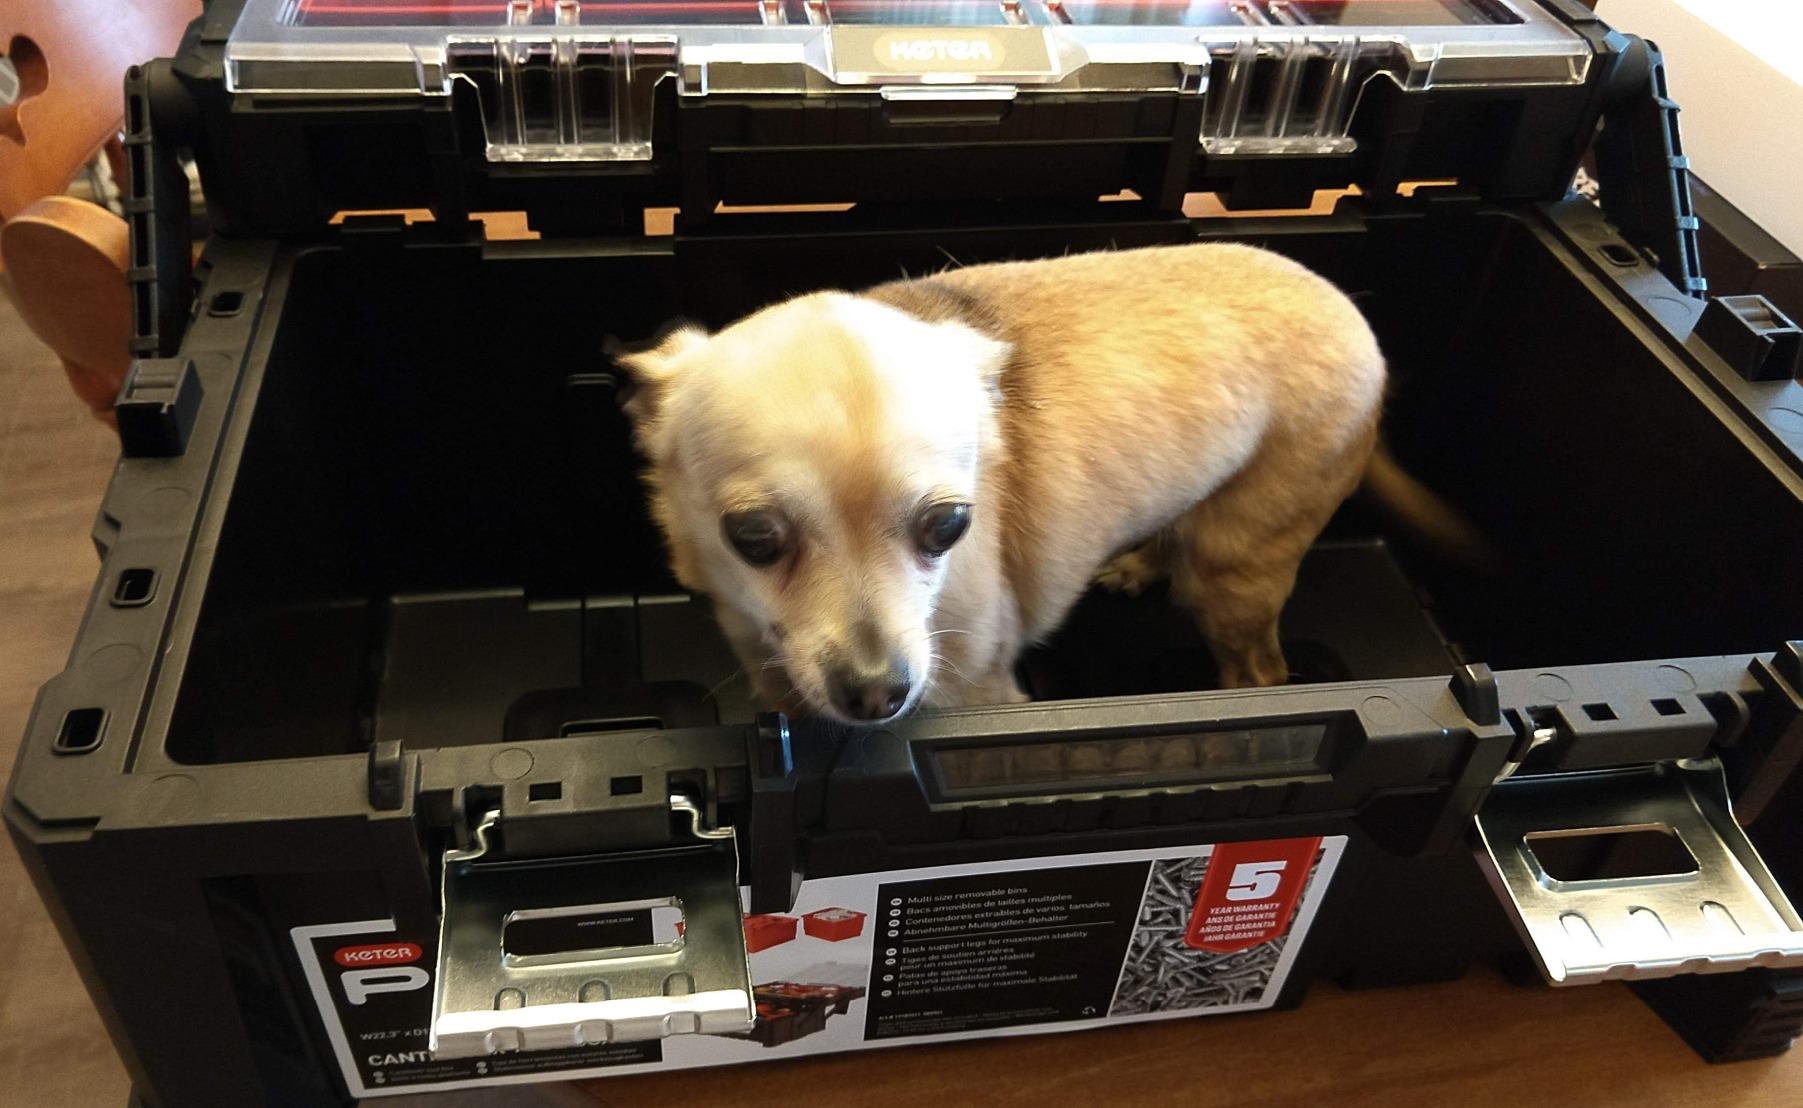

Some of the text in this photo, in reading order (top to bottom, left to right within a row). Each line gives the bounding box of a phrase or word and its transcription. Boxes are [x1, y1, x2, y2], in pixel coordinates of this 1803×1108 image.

[1225, 860, 1288, 901] 5
[907, 896, 932, 904] Multi
[955, 888, 1006, 899] removable
[906, 906, 931, 915] Bacs
[998, 898, 1026, 906] tailles
[1027, 893, 1073, 904] multiples
[1209, 902, 1280, 914] YEAR WARRANTY
[905, 913, 973, 926] Contenedores
[1036, 905, 1065, 913] varios
[1205, 912, 1277, 924] ANS DE GARANTIE
[904, 924, 966, 936] Abnehmbare
[1199, 924, 1222, 934] AÑOS
[1222, 923, 1233, 931] DE
[1224, 930, 1266, 940] GARANTIE
[902, 945, 926, 954] Back
[928, 942, 966, 953] support
[966, 940, 986, 949] legs
[1002, 934, 1050, 944] maximum
[1051, 930, 1089, 940] stability
[413, 1028, 430, 1037] D1
